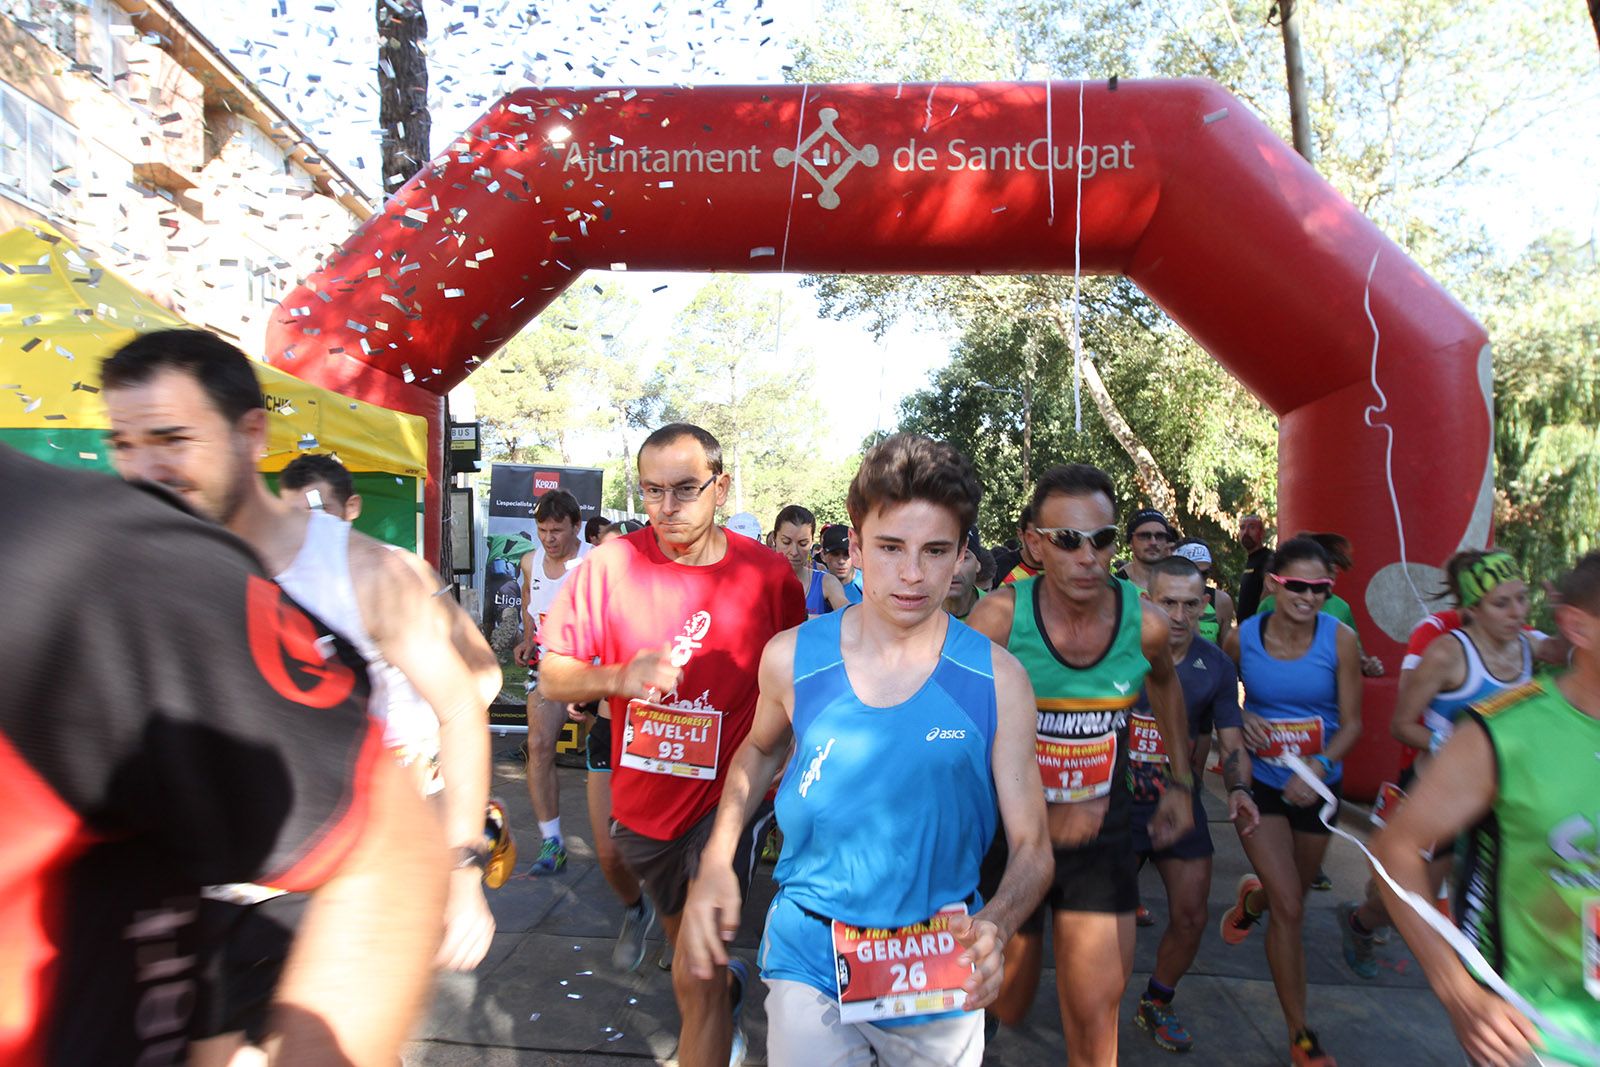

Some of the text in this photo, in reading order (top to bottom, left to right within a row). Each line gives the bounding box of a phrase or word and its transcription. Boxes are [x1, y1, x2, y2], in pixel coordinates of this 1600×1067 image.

[563, 142, 761, 181] Ajuntament
[892, 138, 1135, 179] de SantCugat
[939, 729, 966, 739] asics
[1138, 739, 1157, 752] 53
[658, 741, 685, 760] 93
[856, 931, 954, 963] GERARD
[889, 961, 927, 992] 26
